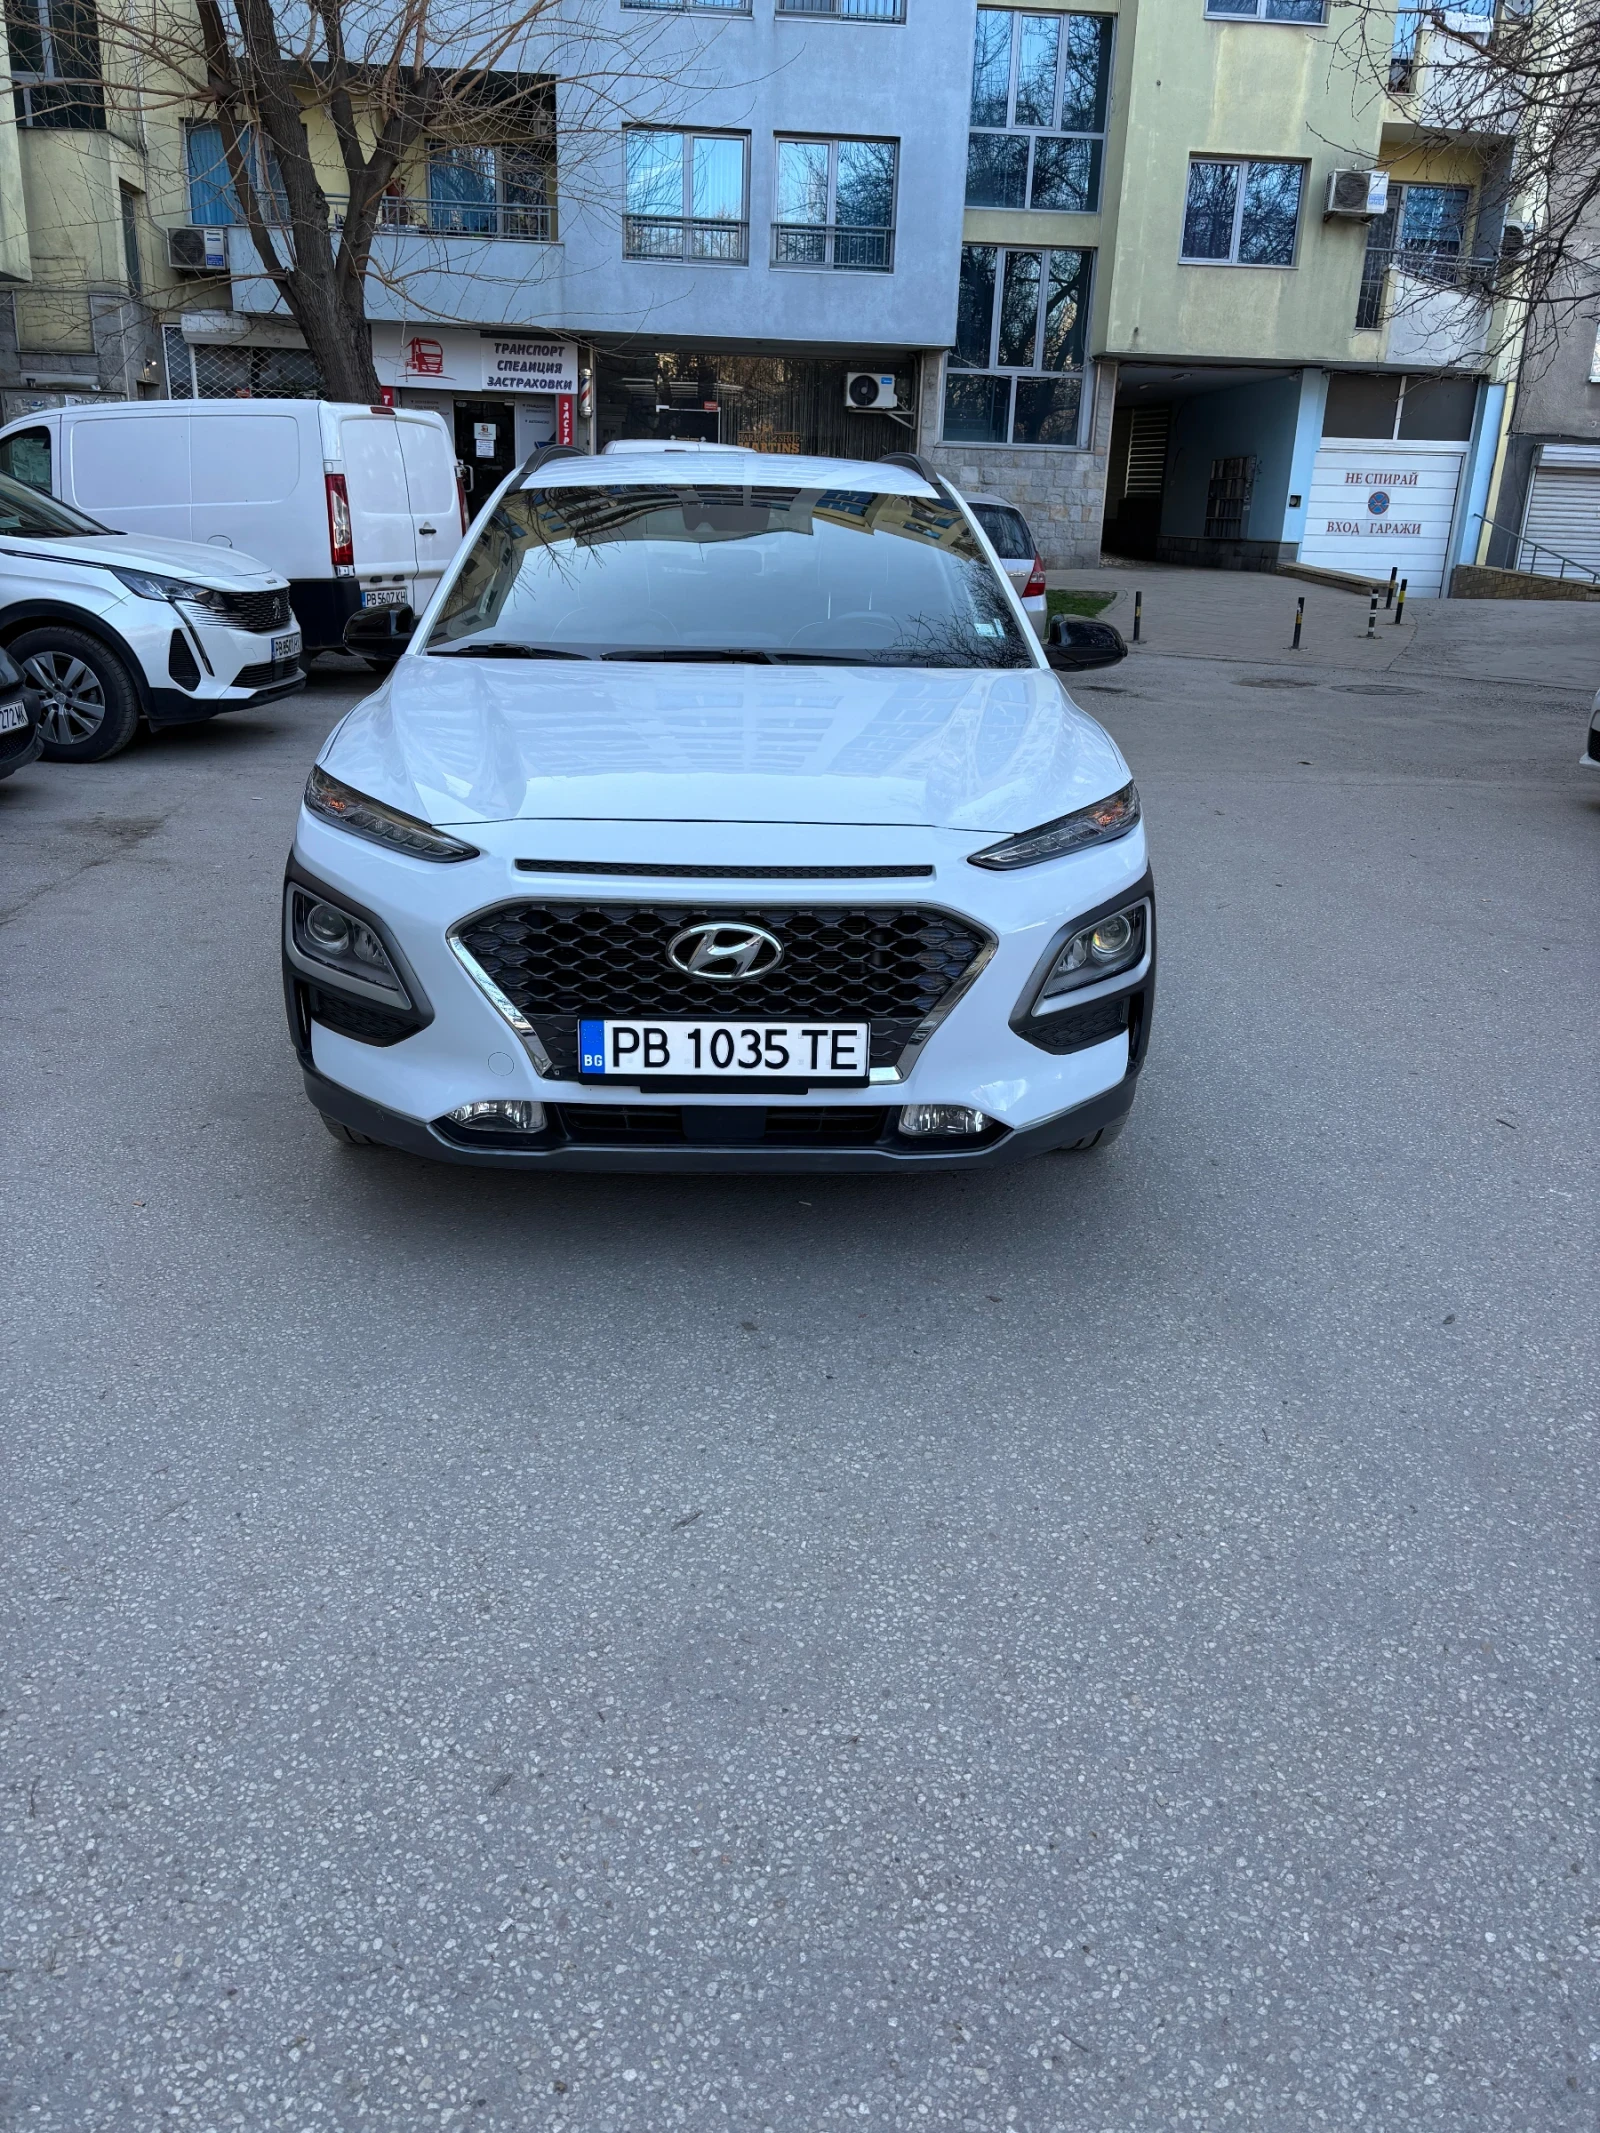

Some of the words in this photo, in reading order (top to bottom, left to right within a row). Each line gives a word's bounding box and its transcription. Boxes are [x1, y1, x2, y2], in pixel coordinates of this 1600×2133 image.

[494, 343, 565, 357] ТРАНСПОРТ
[497, 360, 563, 374] СПЕДИЦИЯ
[487, 376, 572, 390] ЗАСТРАХОВКИ
[779, 434, 800, 442] SHOP
[1344, 472, 1363, 484] НЕ
[1365, 472, 1419, 485] СПИРАЙ
[1326, 521, 1360, 535] ВХОД
[1369, 522, 1422, 535] ГАРАЖИ
[366, 593, 376, 605] PB
[377, 591, 395, 604] 5607
[275, 641, 282, 656] PB
[612, 1027, 670, 1068] PB
[687, 1028, 790, 1069] 1035
[802, 1029, 858, 1070] TE
[584, 1054, 603, 1067] BG
